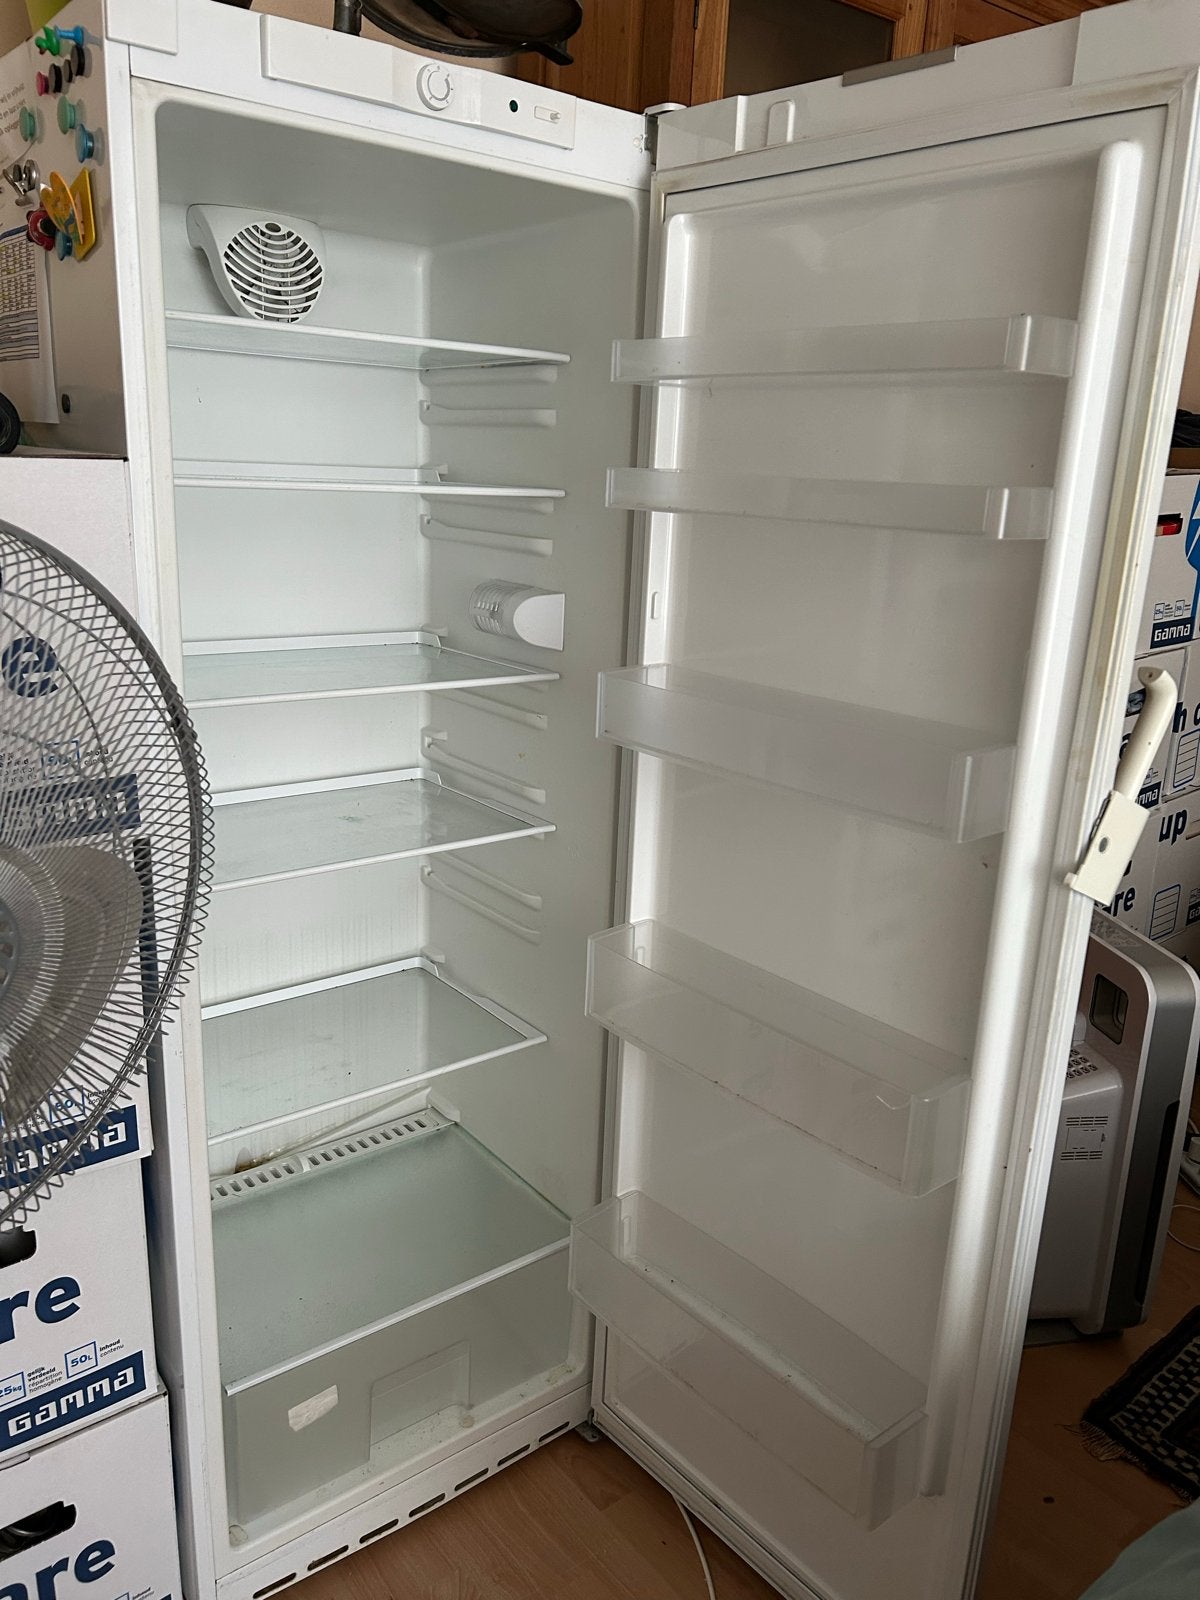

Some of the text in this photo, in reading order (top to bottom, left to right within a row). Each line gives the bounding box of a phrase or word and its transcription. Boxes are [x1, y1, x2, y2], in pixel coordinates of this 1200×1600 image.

[1154, 624, 1191, 642] GAMMA
[1158, 809, 1187, 846] up
[99, 1339, 121, 1352] inhoud
[100, 1344, 124, 1358] contenu
[70, 1354, 93, 1368] 50L
[8, 1367, 135, 1437] GAMMA
